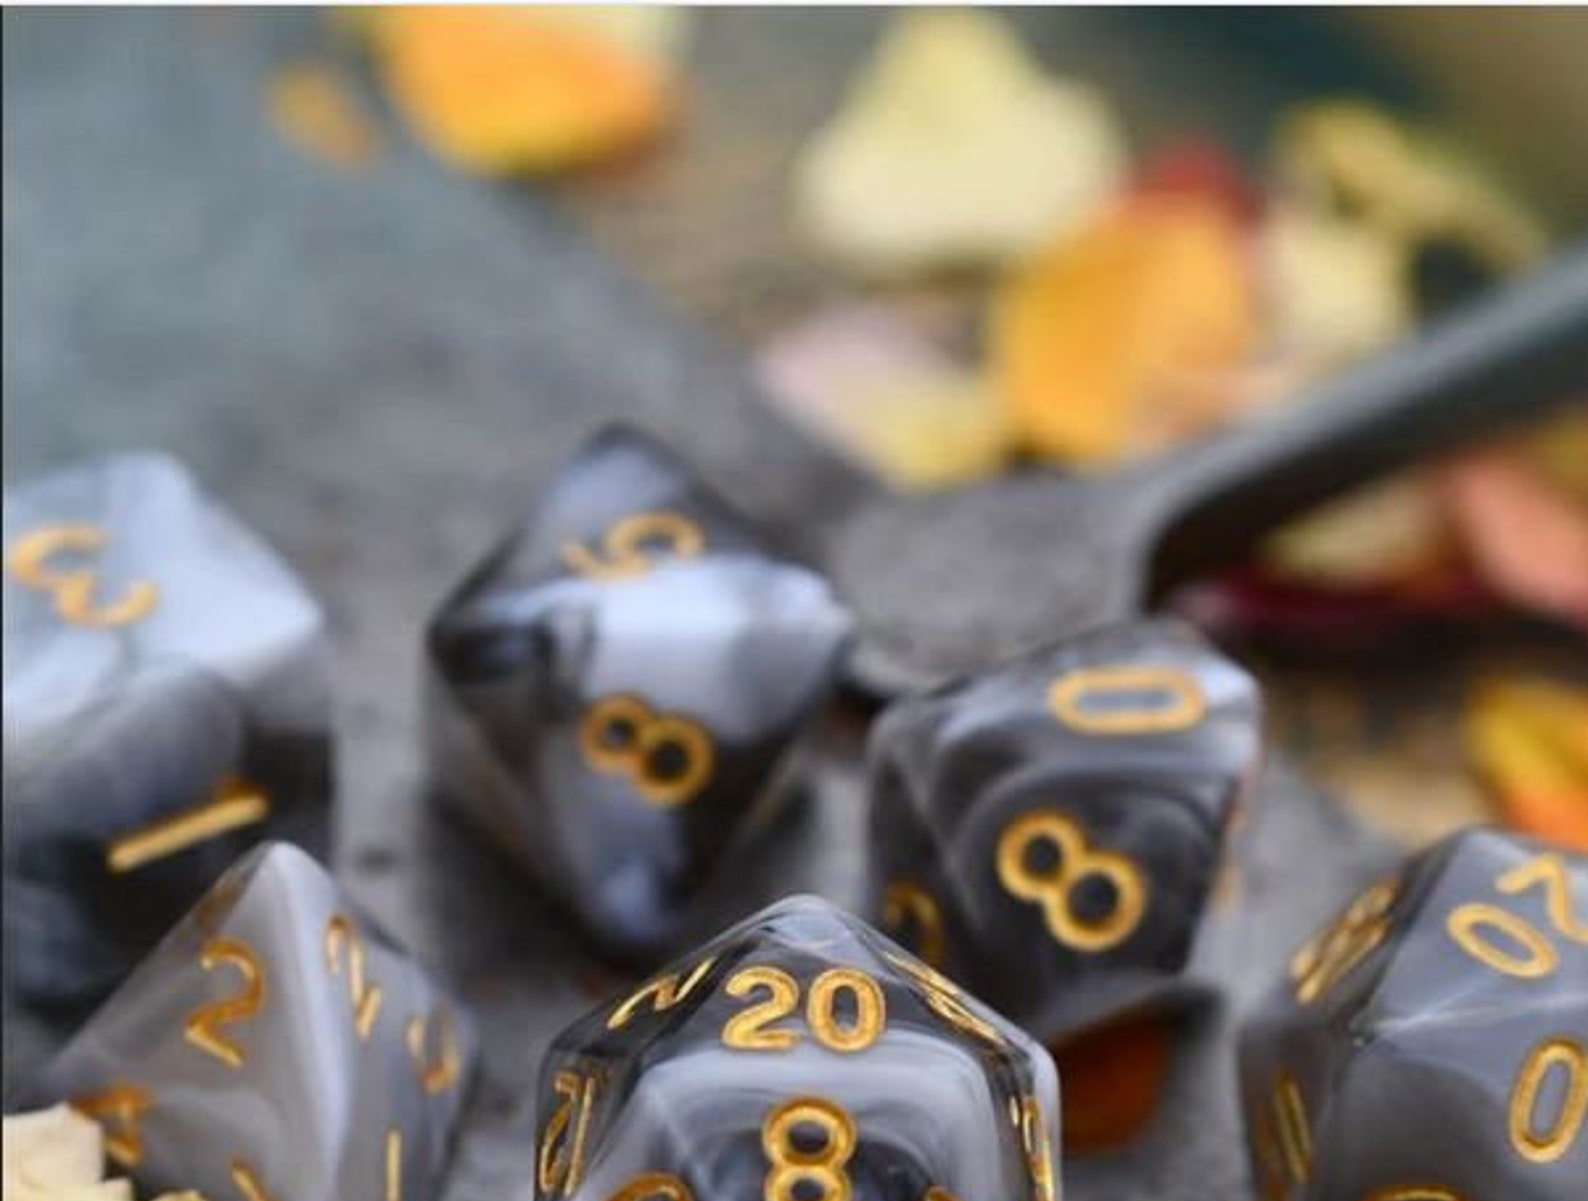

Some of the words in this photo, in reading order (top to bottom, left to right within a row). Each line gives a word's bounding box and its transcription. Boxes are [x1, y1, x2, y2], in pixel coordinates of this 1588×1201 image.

[10, 520, 160, 628] 3
[578, 694, 716, 806] 8
[1048, 664, 1206, 736] 0
[996, 808, 1146, 952] 8
[184, 937, 265, 1067] 2
[720, 964, 887, 1054] 20
